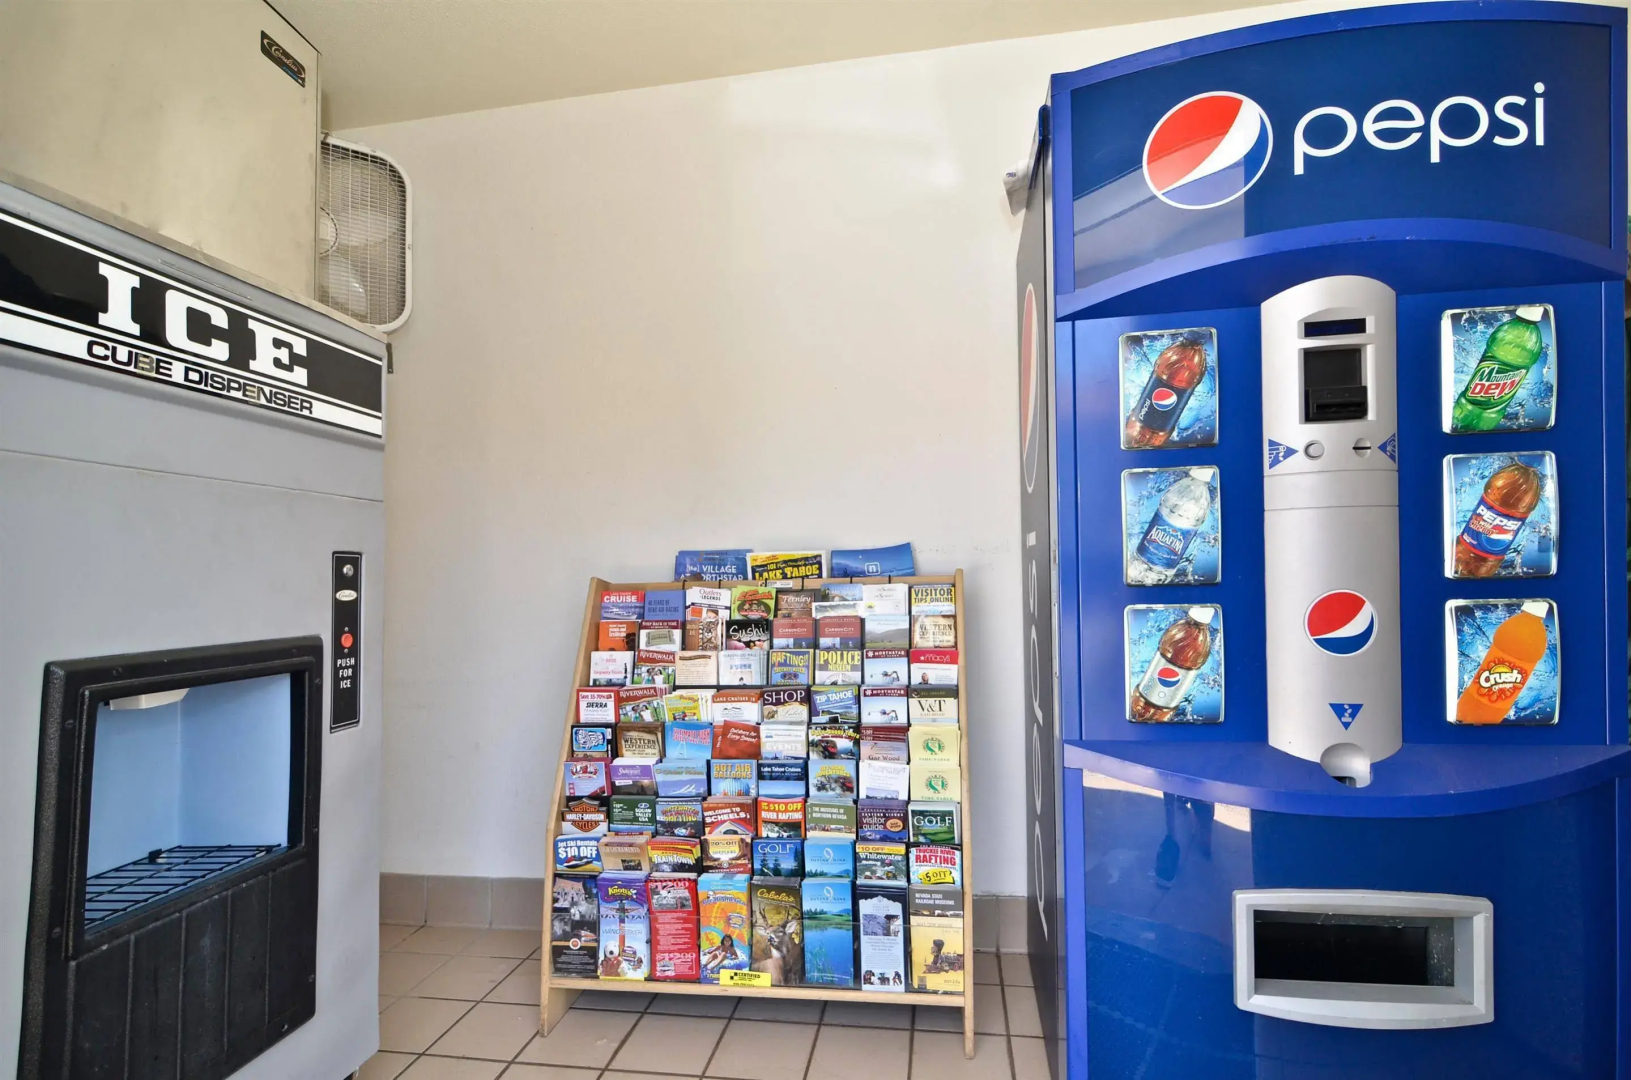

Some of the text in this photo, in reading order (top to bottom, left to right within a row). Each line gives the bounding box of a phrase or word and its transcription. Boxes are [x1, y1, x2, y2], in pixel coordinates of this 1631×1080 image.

[1294, 82, 1545, 175] pepsi
[98, 261, 308, 387] ICE
[86, 339, 313, 415] CUBE DISPENSER
[1139, 398, 1151, 420] pepsi
[1477, 505, 1522, 531] PEPSI
[702, 565, 737, 574] VILLAGE
[755, 565, 819, 580] LAKE TAHOE
[699, 588, 722, 597] Outlets
[913, 588, 953, 597] VISITOR
[604, 595, 638, 603] CRUISE
[930, 596, 953, 604] ONLINE
[730, 624, 763, 639] Sushi
[639, 651, 674, 661] RIVERWALK
[820, 651, 861, 665] POLICE
[924, 654, 950, 663] macy's
[337, 657, 355, 667] PUSH
[339, 668, 353, 678] FOR
[828, 664, 851, 672] MUSEUM
[1480, 669, 1522, 688] Crush
[340, 679, 351, 689] ICE
[620, 688, 656, 698] RIVERWALK
[764, 690, 805, 704] SHOP
[815, 690, 854, 703] ZIP TAHOE
[918, 700, 946, 713] V&T
[1027, 531, 1047, 941] pepsi
[765, 743, 802, 751] EVENTS
[714, 764, 751, 772] HOT AIR
[770, 803, 785, 811] $10
[788, 802, 802, 810] OFF
[703, 808, 731, 816] WELCOME
[705, 813, 746, 823] SCHEELS
[913, 815, 953, 827] GOLF
[862, 823, 884, 831] guide
[559, 847, 597, 858] $10 OFF
[758, 844, 794, 853] GOLF
[653, 855, 693, 865] TRAIN TOWN
[859, 852, 902, 861] Whitewater
[915, 855, 956, 866] RAFTING
[757, 888, 795, 902] Cabela's
